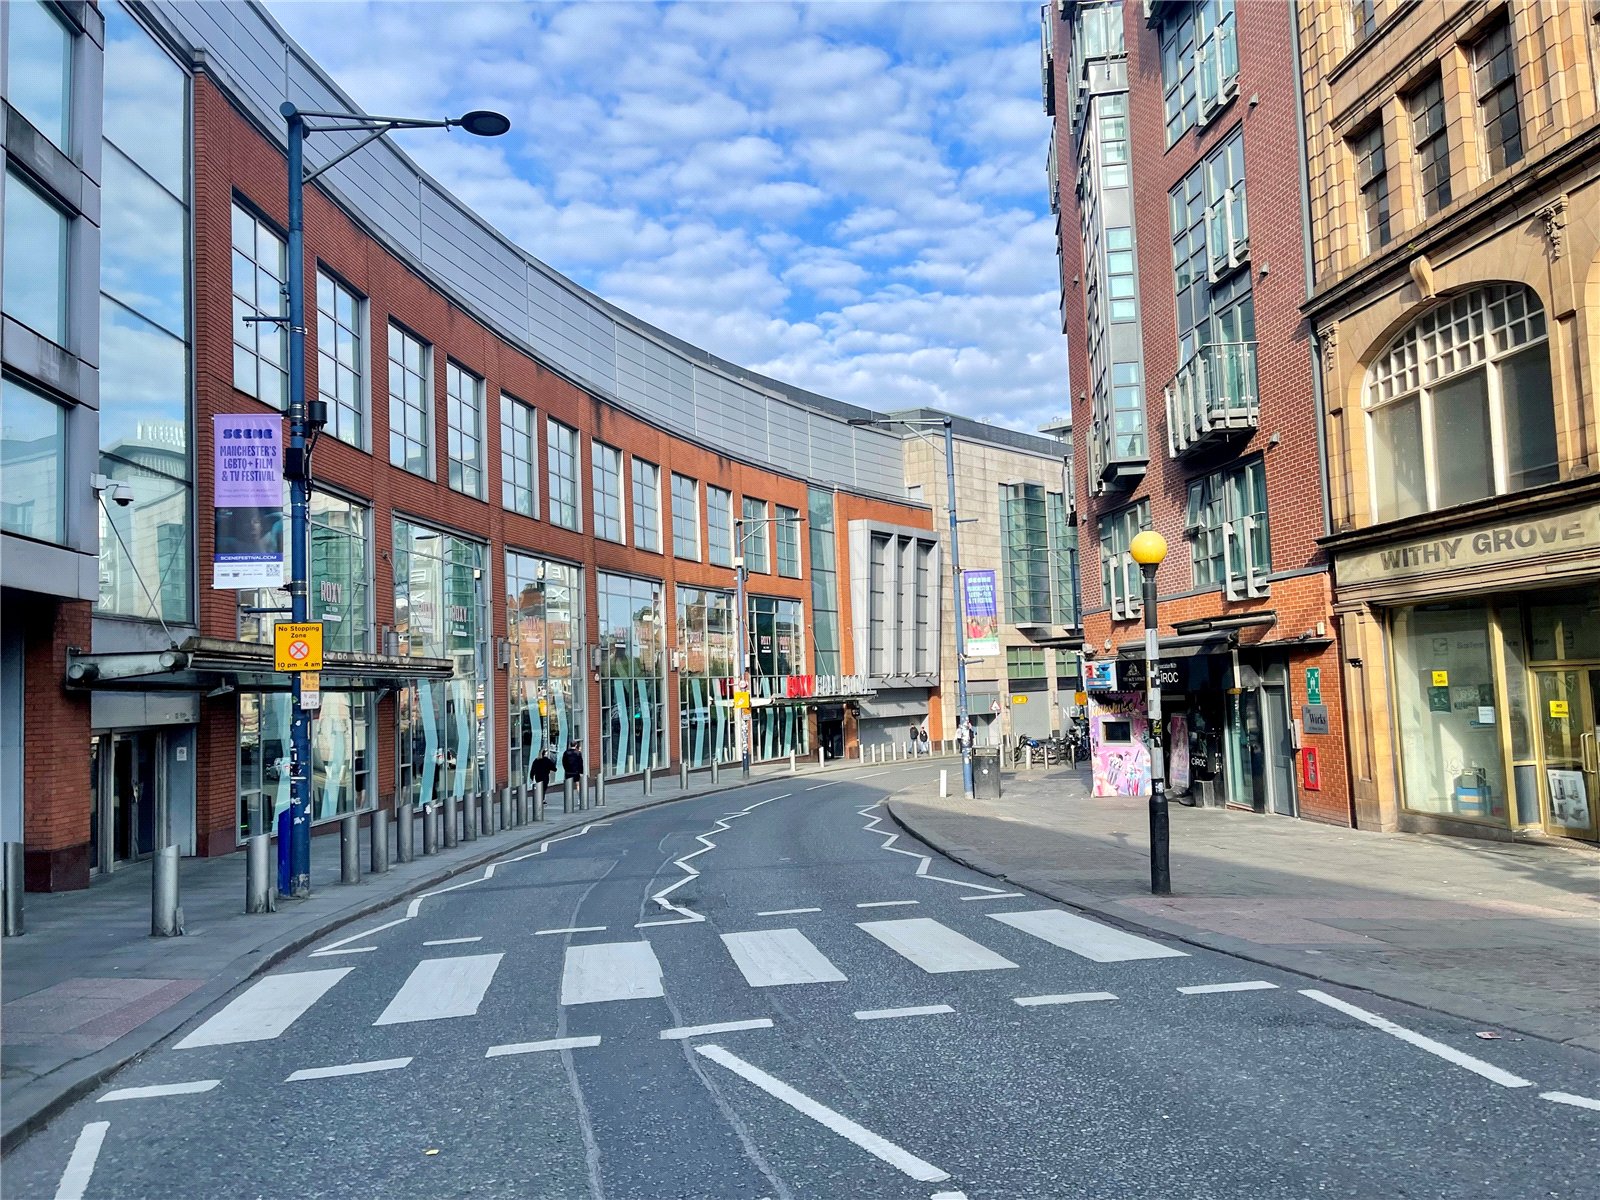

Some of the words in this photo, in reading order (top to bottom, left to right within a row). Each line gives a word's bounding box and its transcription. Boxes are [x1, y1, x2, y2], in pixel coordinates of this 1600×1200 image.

[223, 428, 272, 439] SCENE
[220, 446, 276, 456] MANCHESTER'S
[224, 458, 253, 470] LGBTQ+
[255, 458, 272, 469] FILM
[222, 471, 228, 481] &
[230, 471, 239, 481] TV
[242, 471, 275, 481] FESTIVAL
[1380, 537, 1462, 570] WITHY
[1472, 514, 1585, 556] GROVE
[321, 580, 341, 604] ROXY
[450, 604, 468, 623] ROXY
[290, 625, 320, 633] Stopping
[1309, 713, 1326, 724] Works
